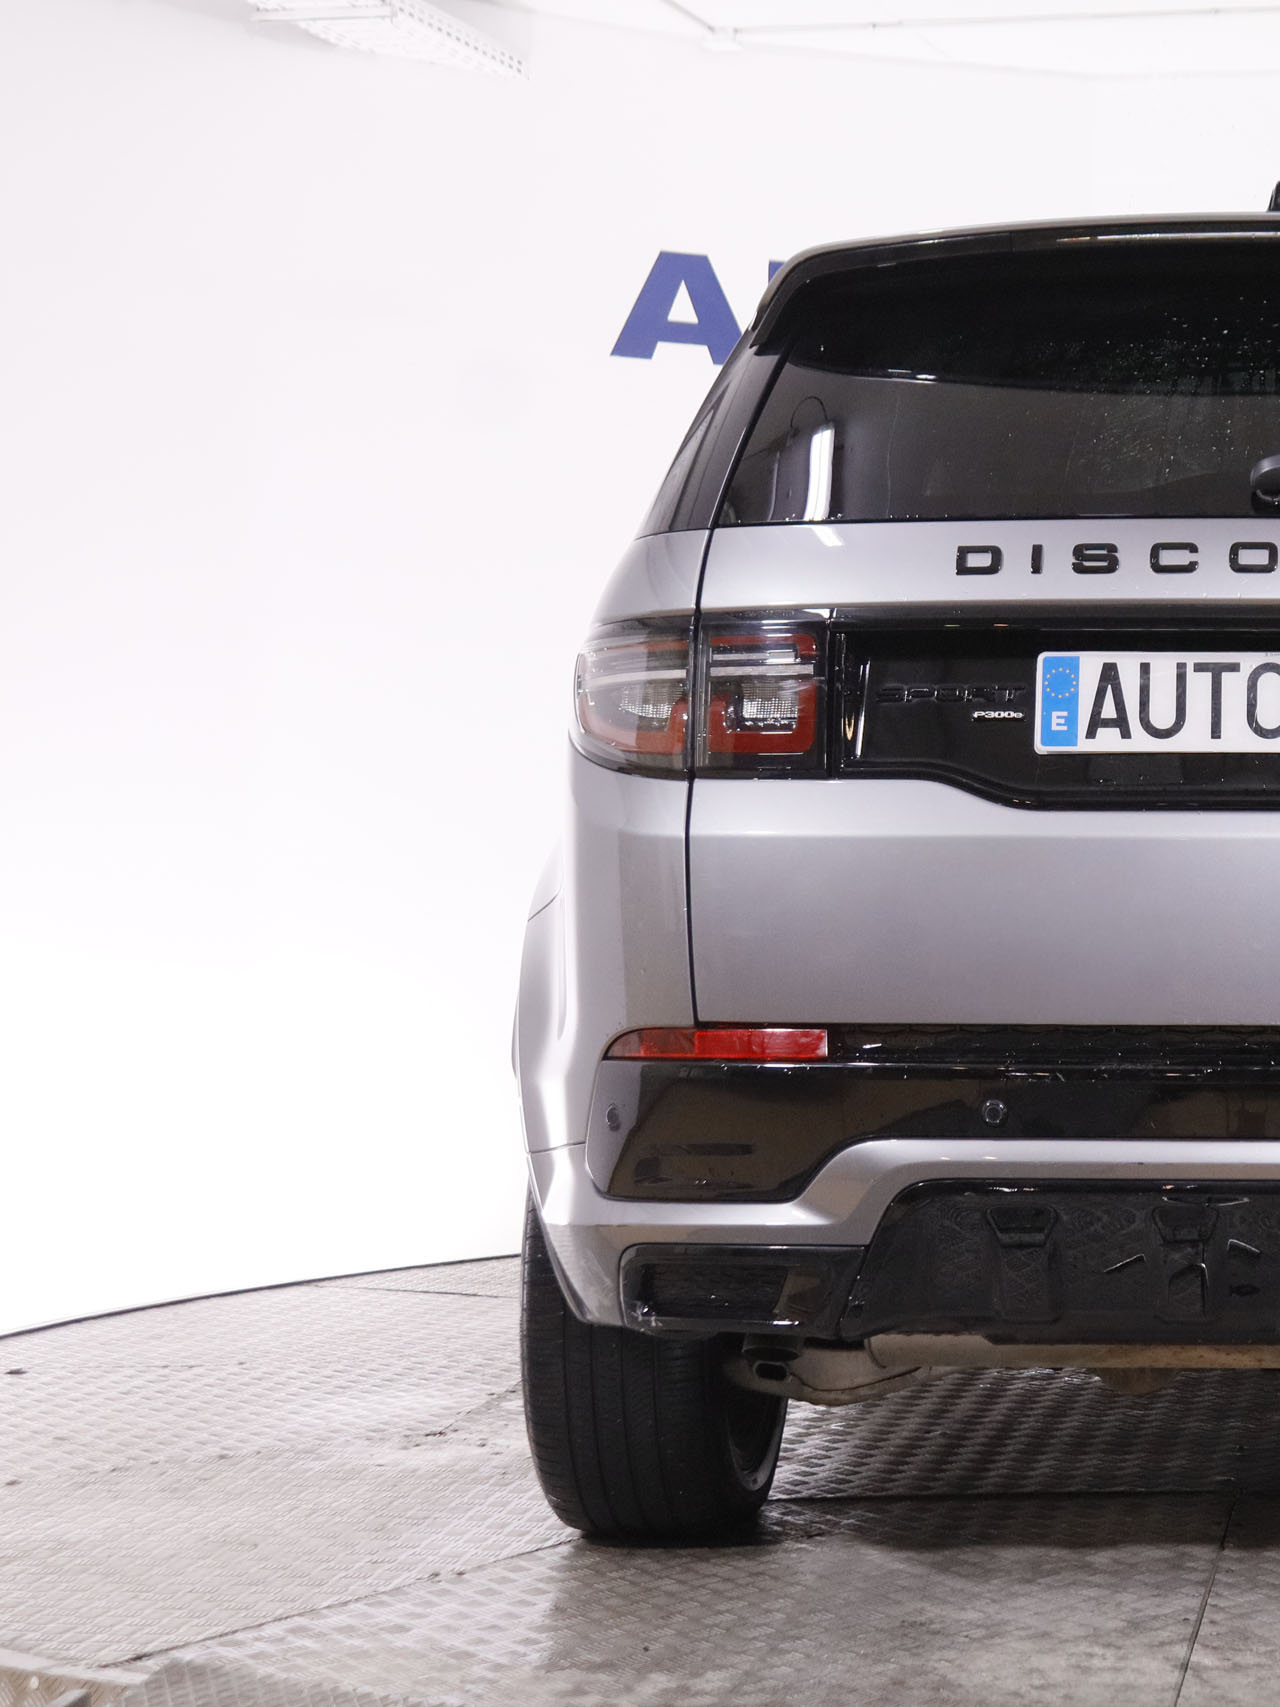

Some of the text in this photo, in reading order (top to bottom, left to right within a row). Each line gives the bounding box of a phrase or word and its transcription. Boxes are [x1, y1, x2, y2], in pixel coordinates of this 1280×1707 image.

[876, 684, 1026, 703] SPORT
[972, 710, 1024, 719] P300e
[1050, 711, 1068, 731] E
